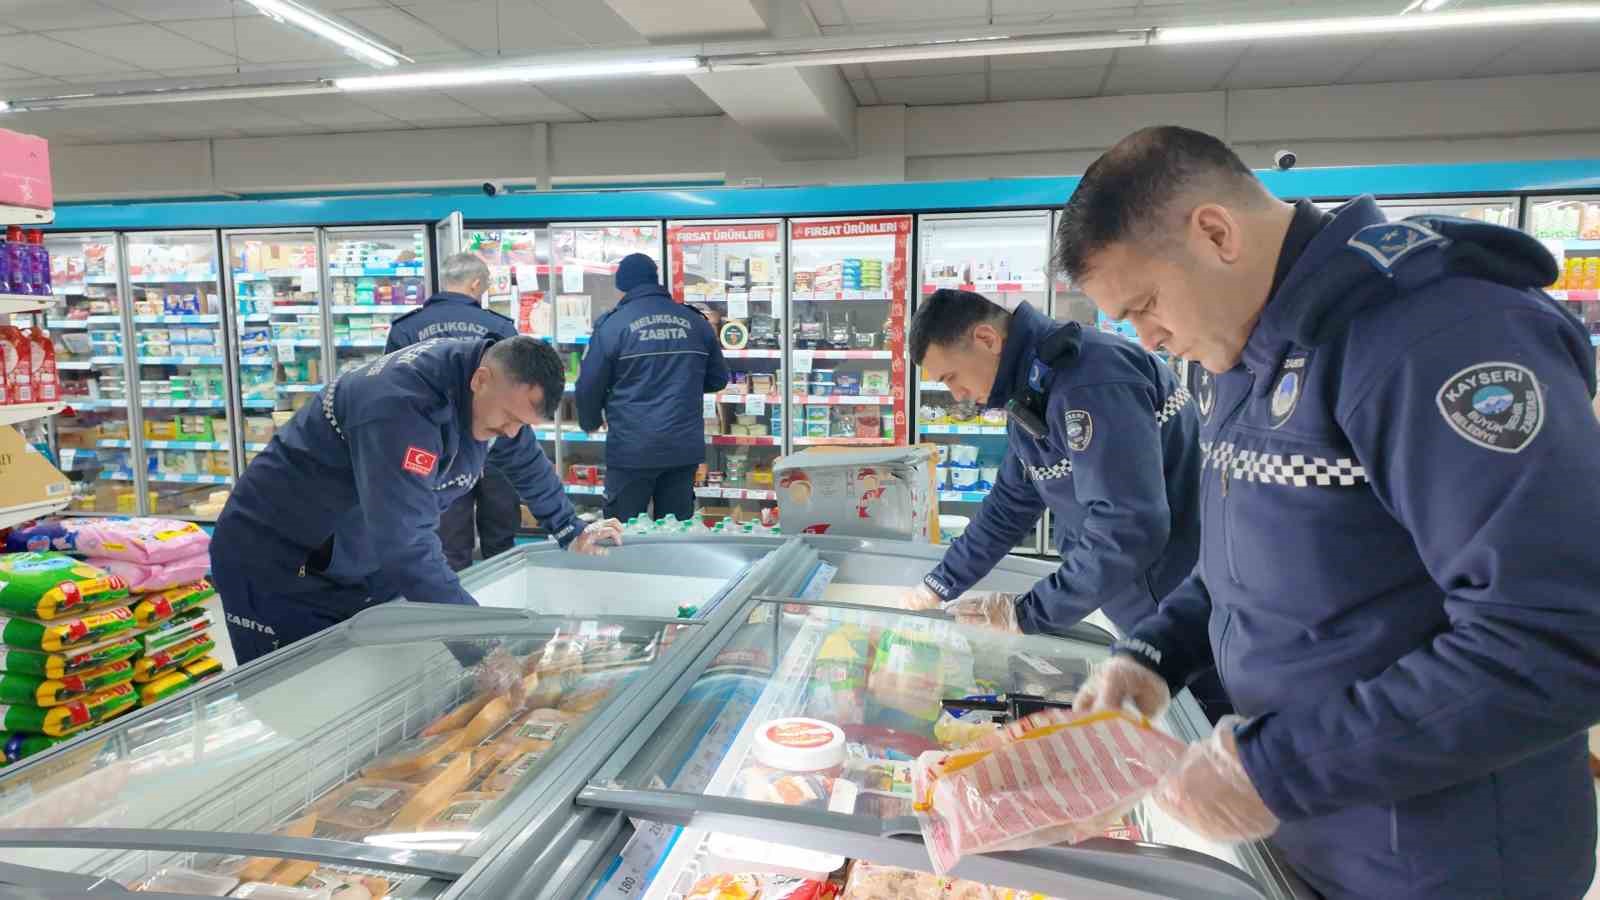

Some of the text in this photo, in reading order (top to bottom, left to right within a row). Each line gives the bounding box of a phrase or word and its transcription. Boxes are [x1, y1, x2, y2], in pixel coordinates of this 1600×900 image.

[676, 231, 711, 241] FIRSAT
[804, 225, 841, 237] FIRSAT
[639, 327, 688, 341] ZABITA
[226, 612, 276, 635] ZABITA
[617, 876, 636, 894] 180
